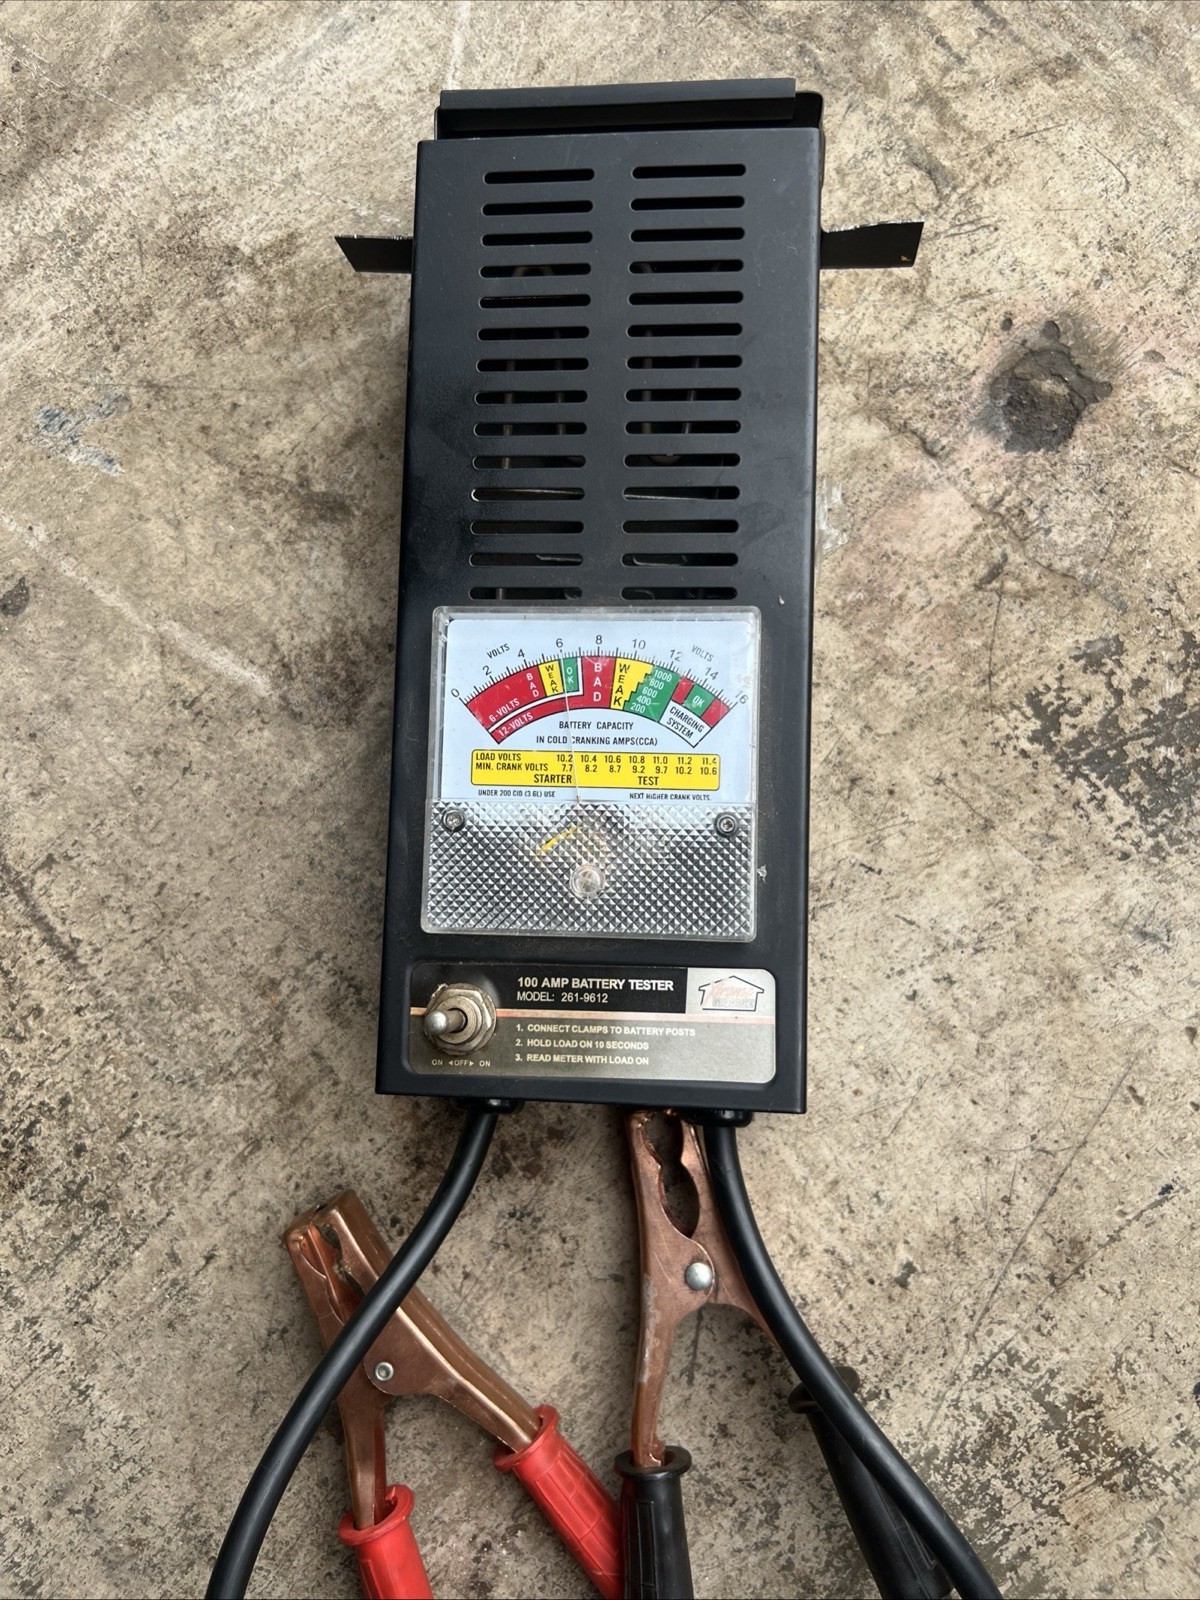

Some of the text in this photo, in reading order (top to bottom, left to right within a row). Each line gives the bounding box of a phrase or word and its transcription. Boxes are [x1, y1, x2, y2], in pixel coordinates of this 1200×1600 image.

[486, 643, 510, 659] VOLTS
[692, 645, 713, 662] VOLTS
[450, 635, 749, 704] 0 2 4 6 8 10 12 14 16
[566, 667, 574, 683] OK
[545, 665, 558, 693] WEAK
[593, 662, 603, 702] BAD
[654, 670, 672, 682] 1000
[526, 673, 539, 697] BAD
[614, 663, 630, 706] WEAK
[649, 679, 664, 690] 800
[642, 687, 658, 698] 600
[636, 695, 650, 706] 400
[692, 696, 705, 708] OK
[489, 698, 520, 722] 6-VOLTS
[630, 702, 646, 713] 200
[498, 712, 533, 737] 12-VOLTS
[559, 721, 634, 730] BATTERY CAPACITY
[670, 706, 704, 733] CHARGING
[667, 718, 694, 738] SYSTEM
[613, 737, 658, 746] AMPS(CCA)
[557, 754, 573, 762] 10.2
[605, 755, 621, 763] 10.6
[629, 756, 645, 764] 10.8
[653, 756, 668, 764] 11.0
[534, 774, 659, 785] STARTER TEST
[518, 977, 674, 991] 100 AMP BATTERY TESTER
[517, 991, 608, 1003] MODEL: 261-9612
[528, 1024, 570, 1032] CONNECT
[572, 1025, 608, 1033] CLAMPS
[624, 1027, 665, 1036] BATTERY
[666, 1028, 696, 1036] POSTS
[527, 1039, 551, 1047] HOLD
[606, 1041, 649, 1050] SECONDS
[553, 1054, 583, 1062] METER
[609, 1056, 634, 1064] LOAD
[636, 1057, 648, 1065] ON
